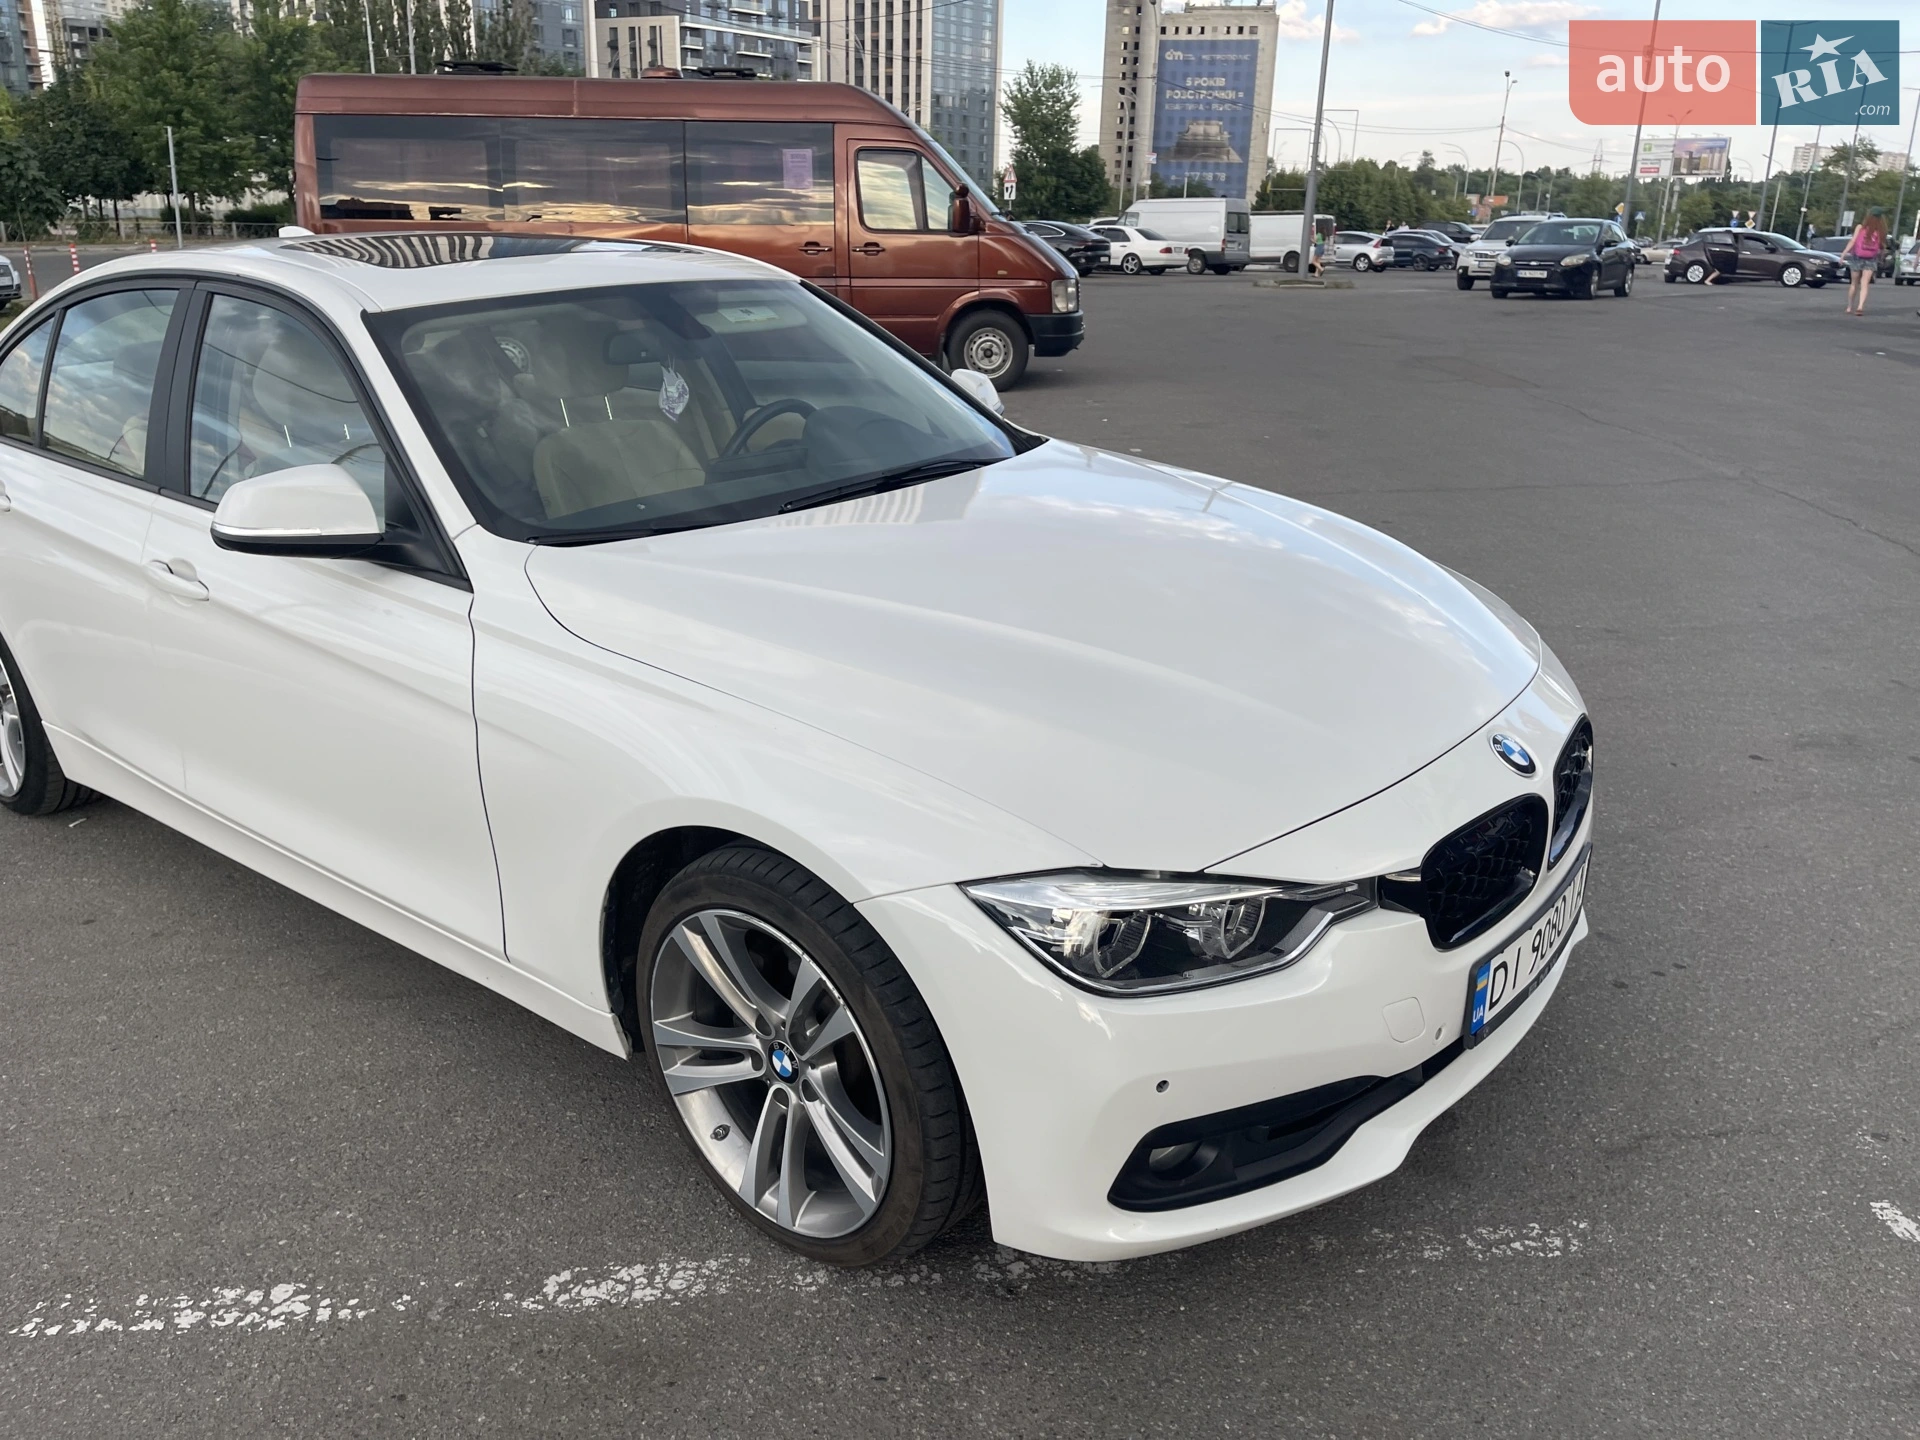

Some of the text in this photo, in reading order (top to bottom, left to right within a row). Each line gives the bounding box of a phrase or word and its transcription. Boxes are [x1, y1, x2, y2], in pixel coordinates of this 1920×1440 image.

[1489, 946, 1521, 1011] DI
[1529, 895, 1566, 975] 9080
[1472, 1004, 1484, 1022] UA
[773, 1042, 799, 1069] BMW
